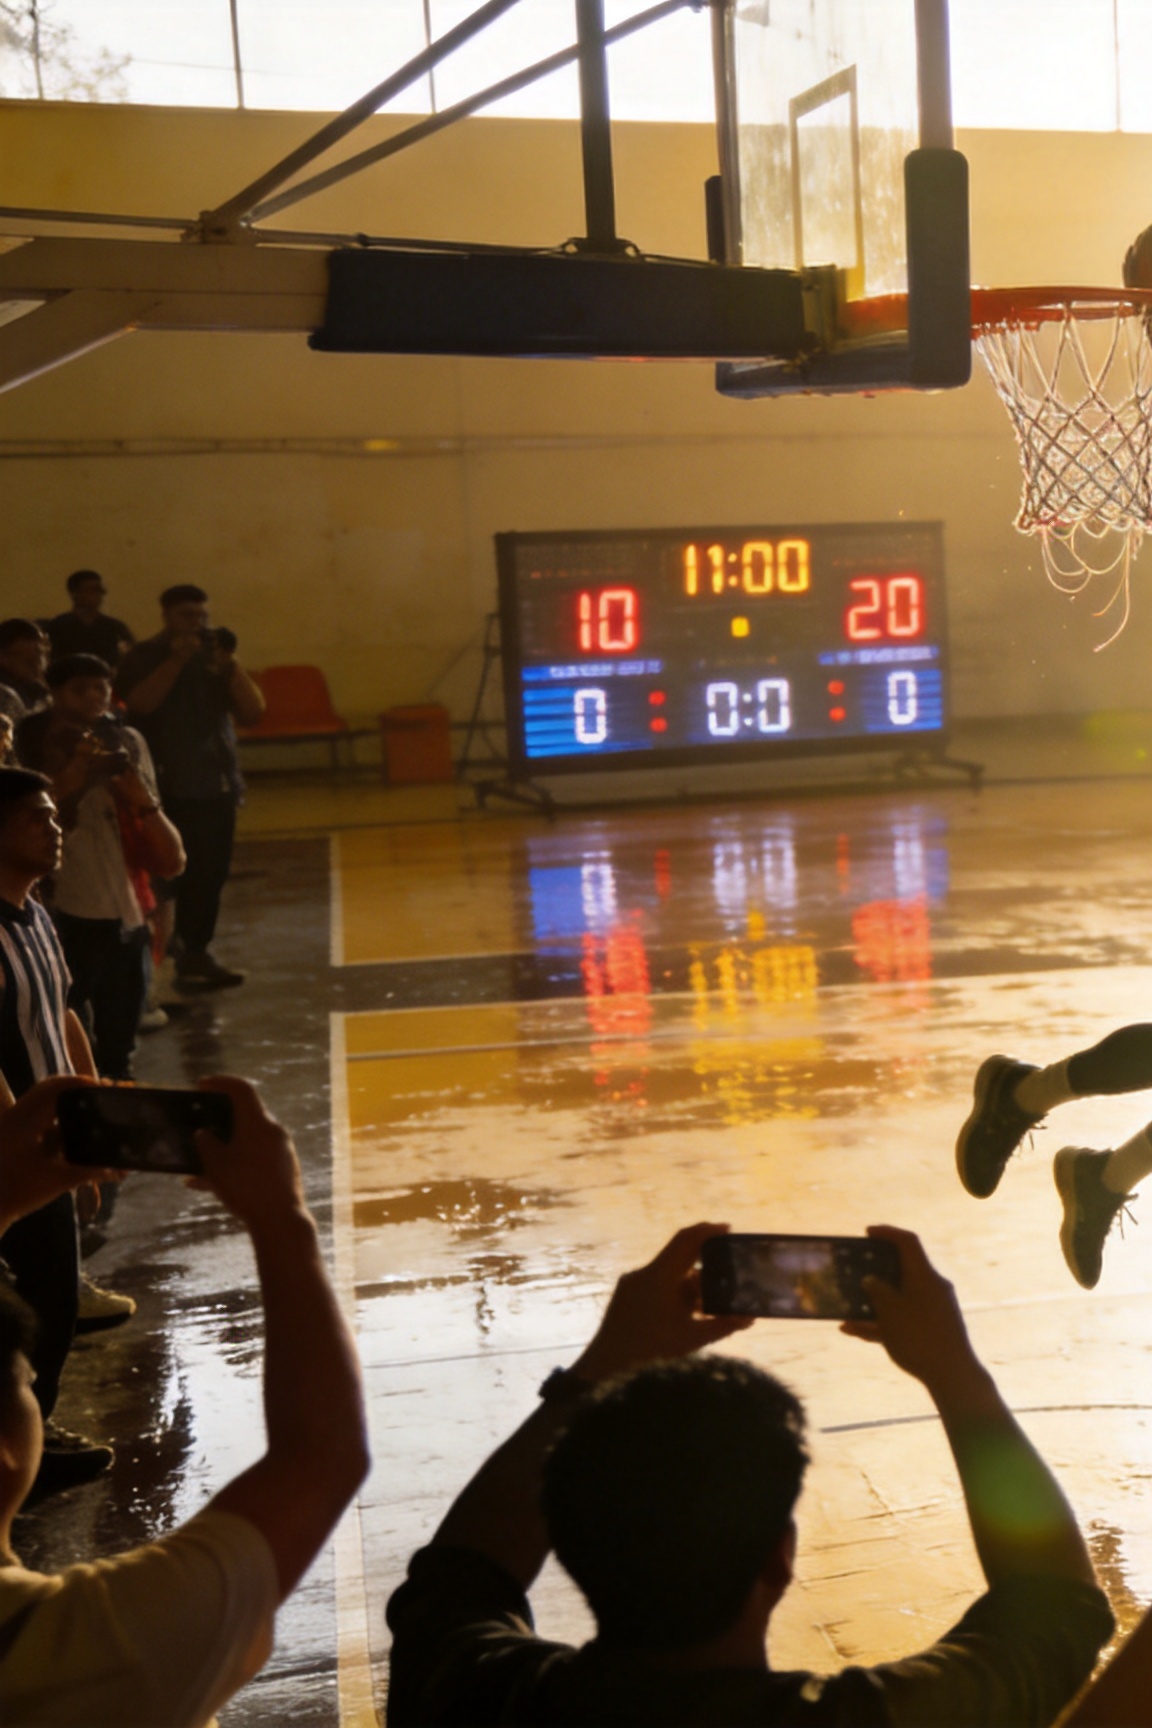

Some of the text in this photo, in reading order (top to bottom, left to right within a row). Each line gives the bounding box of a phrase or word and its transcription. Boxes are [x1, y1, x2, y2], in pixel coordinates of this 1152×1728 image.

[685, 539, 811, 595] 11:00
[577, 588, 637, 651] 10
[848, 577, 920, 640] 20
[574, 688, 607, 744] 0
[706, 678, 791, 737] 0:0
[887, 671, 917, 725] 0
